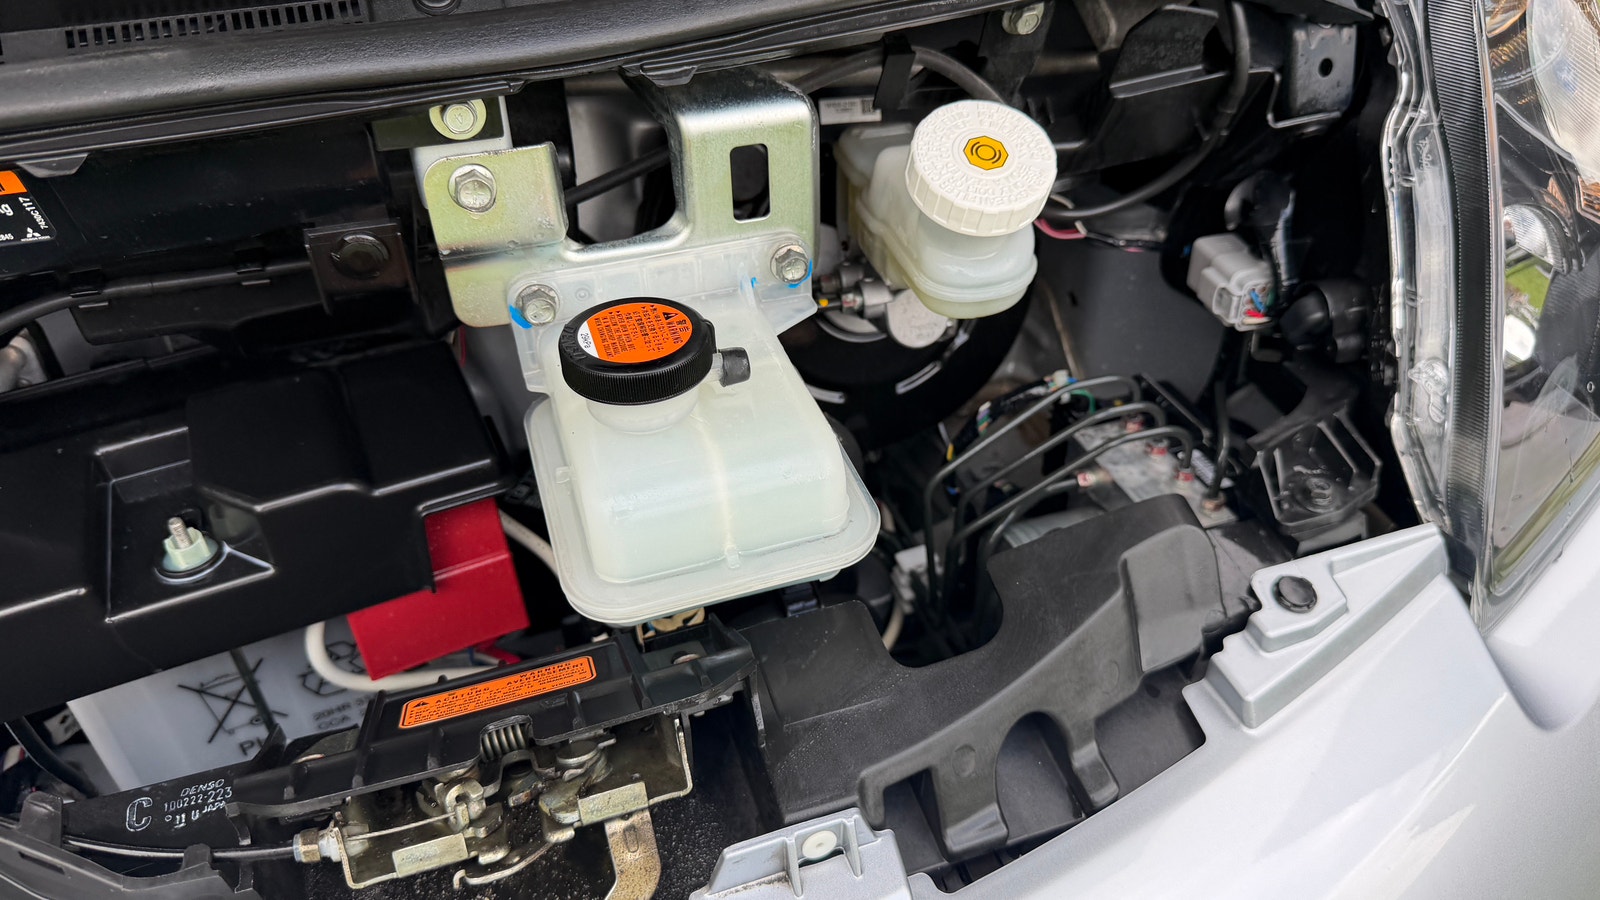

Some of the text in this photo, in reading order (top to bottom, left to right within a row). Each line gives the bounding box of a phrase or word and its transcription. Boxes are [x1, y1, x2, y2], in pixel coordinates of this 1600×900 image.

[0, 203, 14, 216] g
[665, 321, 684, 344] WARNING
[520, 662, 571, 678] WARNING
[436, 687, 490, 704] ACHTUNG
[180, 778, 224, 796] DENSO
[164, 786, 232, 812] 100222-223
[126, 796, 153, 832] C
